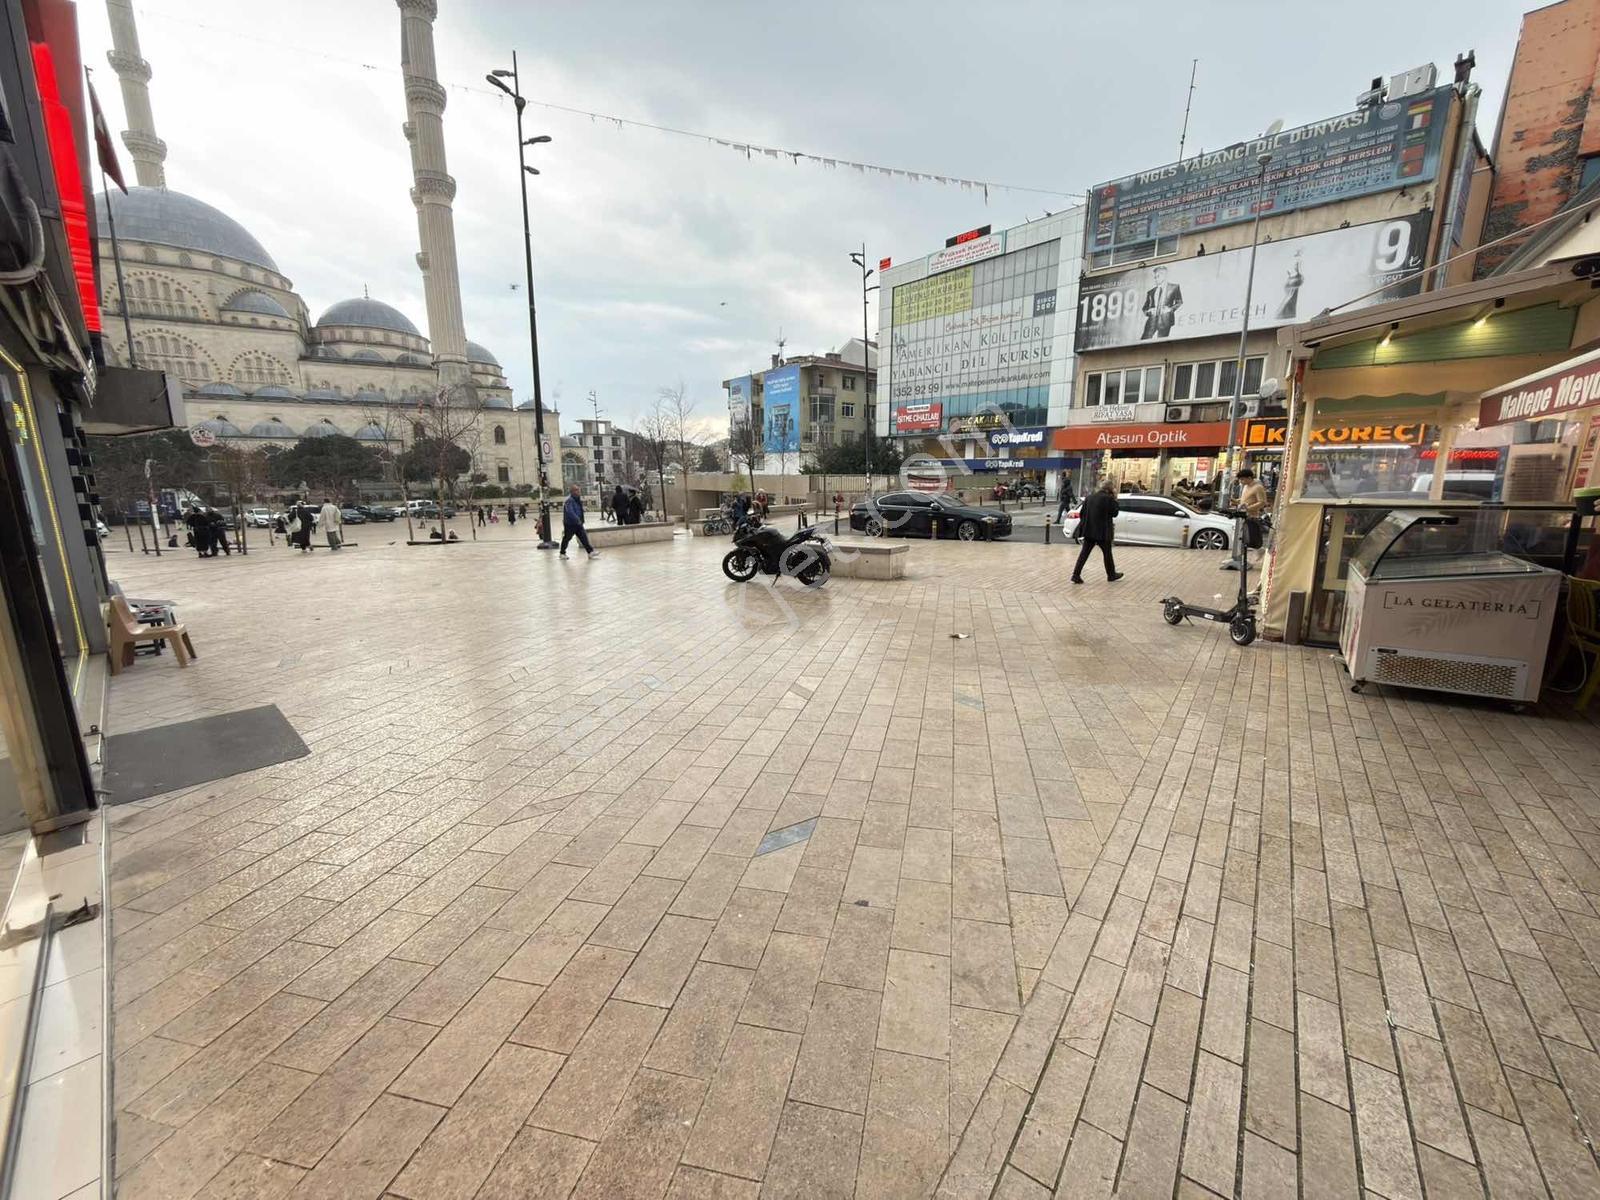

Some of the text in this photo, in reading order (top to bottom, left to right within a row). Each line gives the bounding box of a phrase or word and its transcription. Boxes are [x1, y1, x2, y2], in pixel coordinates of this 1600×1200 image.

[1180, 145, 1252, 173] YABANCI
[1289, 110, 1371, 144] DÜNYASI
[1376, 220, 1411, 271] 9
[1036, 302, 1055, 311] 2007
[1080, 289, 1137, 324] 1899
[893, 363, 949, 380] YABANCI
[1000, 345, 1053, 364] KURSU
[896, 387, 913, 398] 352
[915, 385, 927, 396] 92
[928, 383, 940, 394] 99
[1498, 386, 1553, 421] Maltepe
[1096, 430, 1188, 448] Atasun Optik
[1393, 595, 1529, 615] LA GELATERIA
